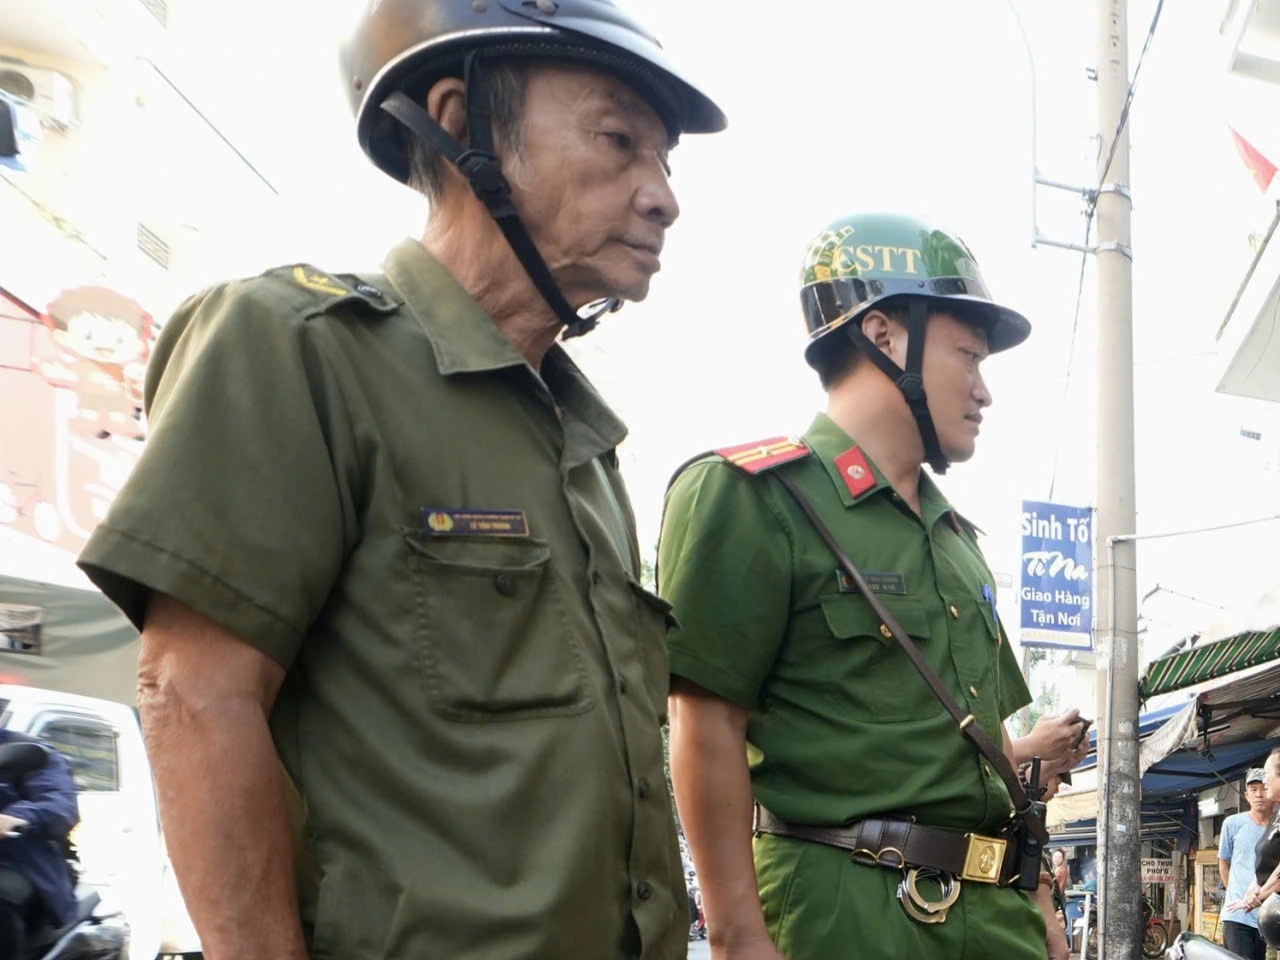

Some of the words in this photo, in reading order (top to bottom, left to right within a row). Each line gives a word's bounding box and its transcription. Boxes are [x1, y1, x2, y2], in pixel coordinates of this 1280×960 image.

[834, 244, 921, 275] CSTT
[1020, 512, 1063, 541] Sinh
[1021, 586, 1053, 603] Giao
[1054, 589, 1090, 609] Hàng
[1030, 608, 1055, 627] Tận
[1057, 611, 1082, 627] Nơi
